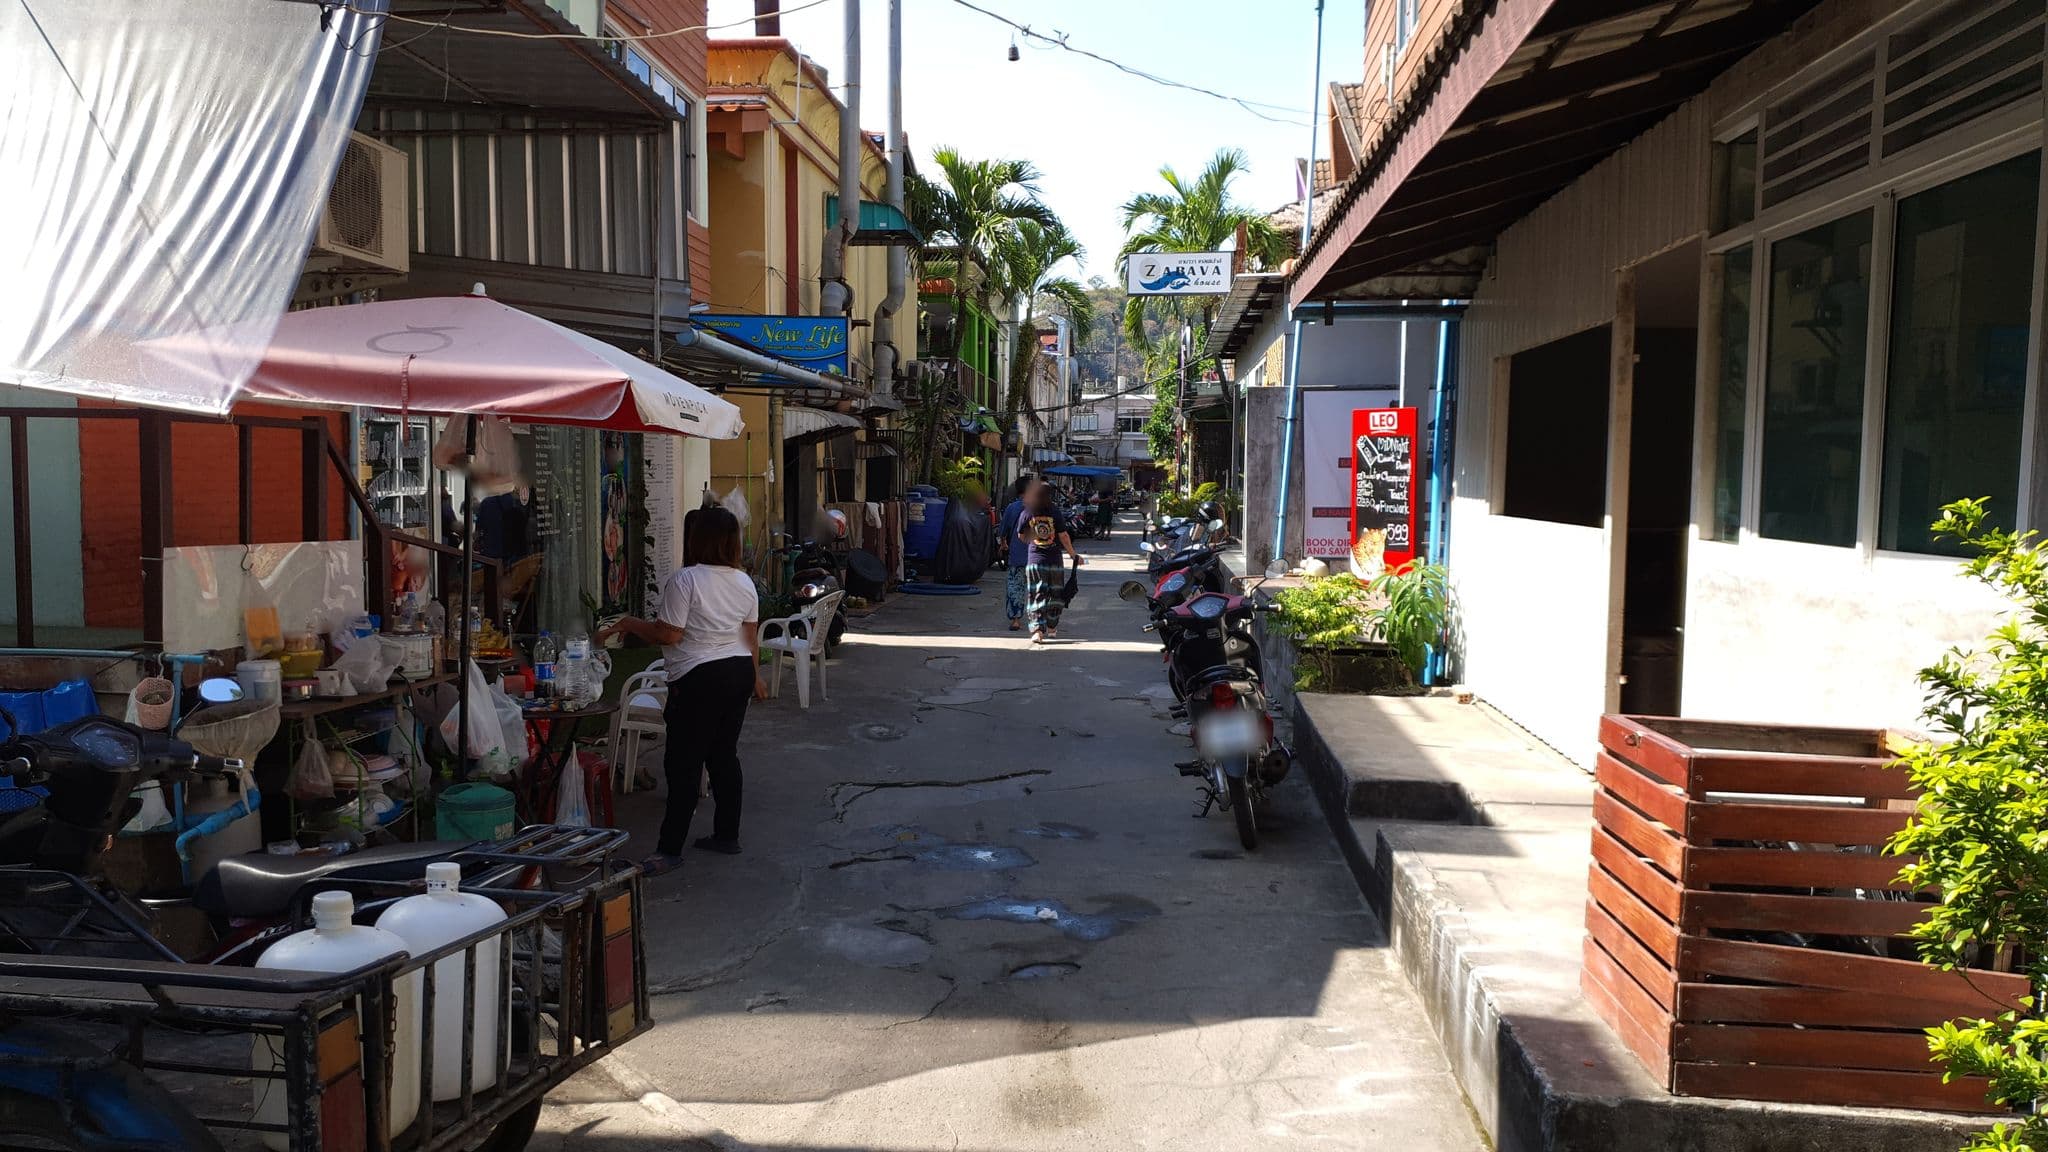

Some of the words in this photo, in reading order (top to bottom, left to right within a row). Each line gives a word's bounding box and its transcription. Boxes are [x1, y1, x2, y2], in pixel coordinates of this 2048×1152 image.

[1193, 277, 1221, 286] house
[751, 319, 803, 343] New
[806, 325, 845, 350] Life
[1372, 414, 1396, 428] LEO
[1387, 523, 1409, 541] 599
[1306, 538, 1335, 547] BOOK
[1307, 547, 1327, 555] AND
